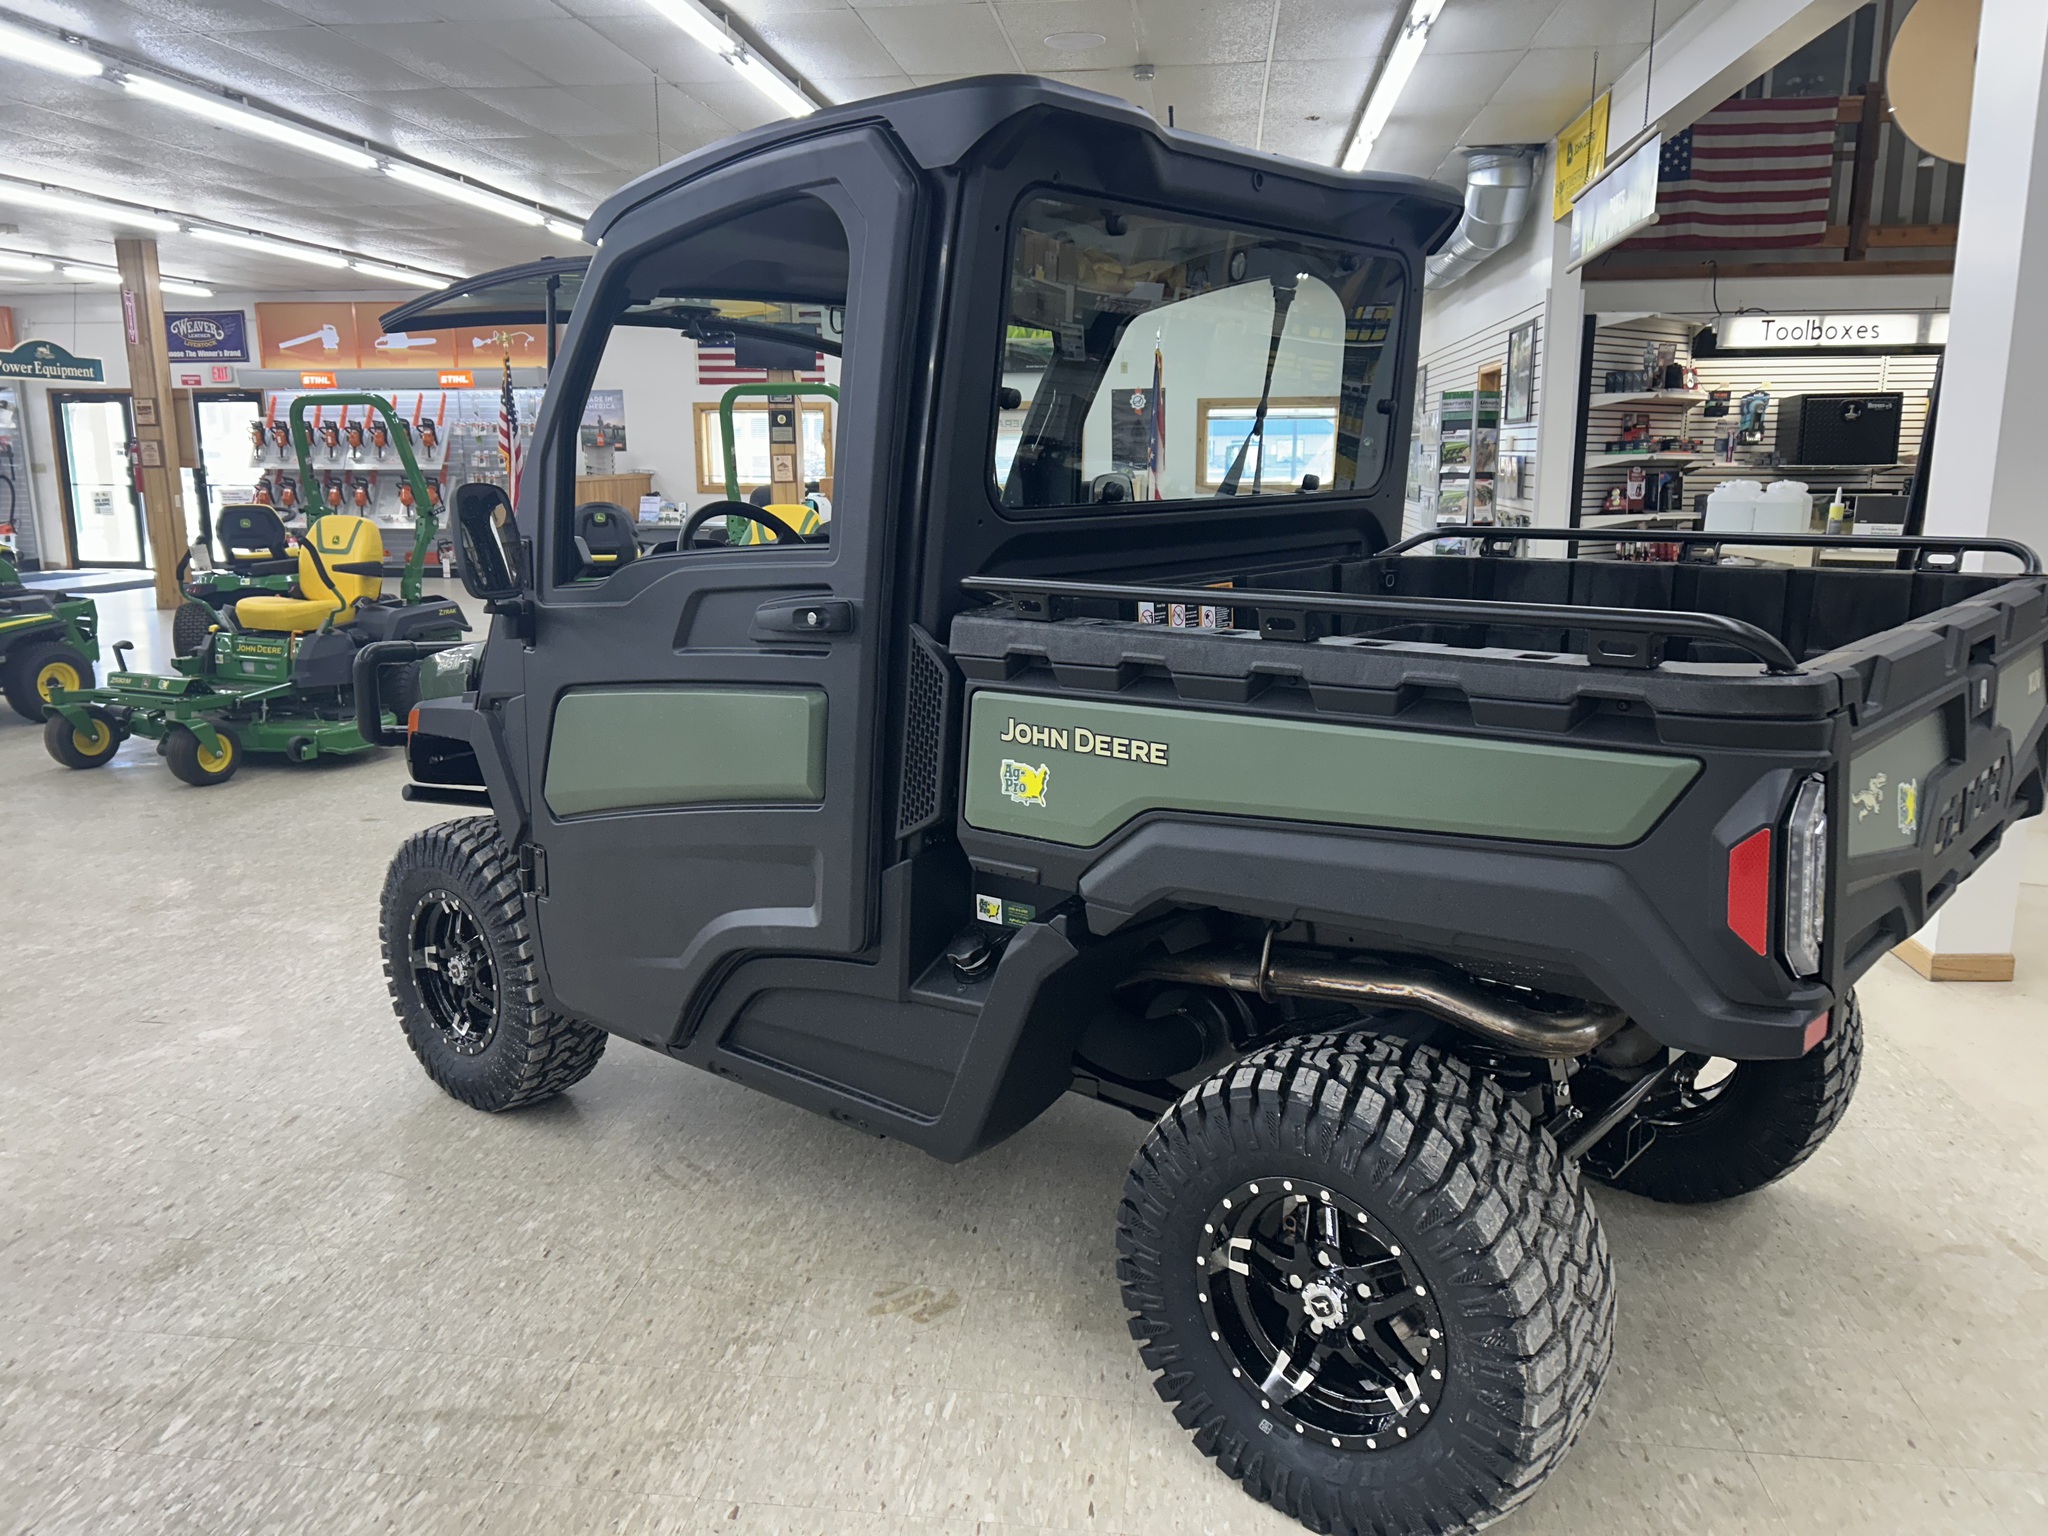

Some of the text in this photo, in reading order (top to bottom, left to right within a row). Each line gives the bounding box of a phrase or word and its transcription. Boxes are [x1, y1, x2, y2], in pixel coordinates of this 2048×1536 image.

[171, 318, 225, 340] WEAVER
[1761, 319, 1880, 341] Toolboxes
[184, 340, 218, 348] LIVESTOCK
[224, 349, 241, 357] Brand
[34, 360, 94, 379] Equipment
[212, 366, 229, 382] EXIT
[302, 376, 331, 385] STIHL
[440, 375, 469, 384] STIHL
[236, 644, 282, 654] JOHN DEERE
[1000, 717, 1169, 767] JOHN DEERE
[1003, 763, 1026, 781] Ag-
[1004, 777, 1027, 793] Pro
